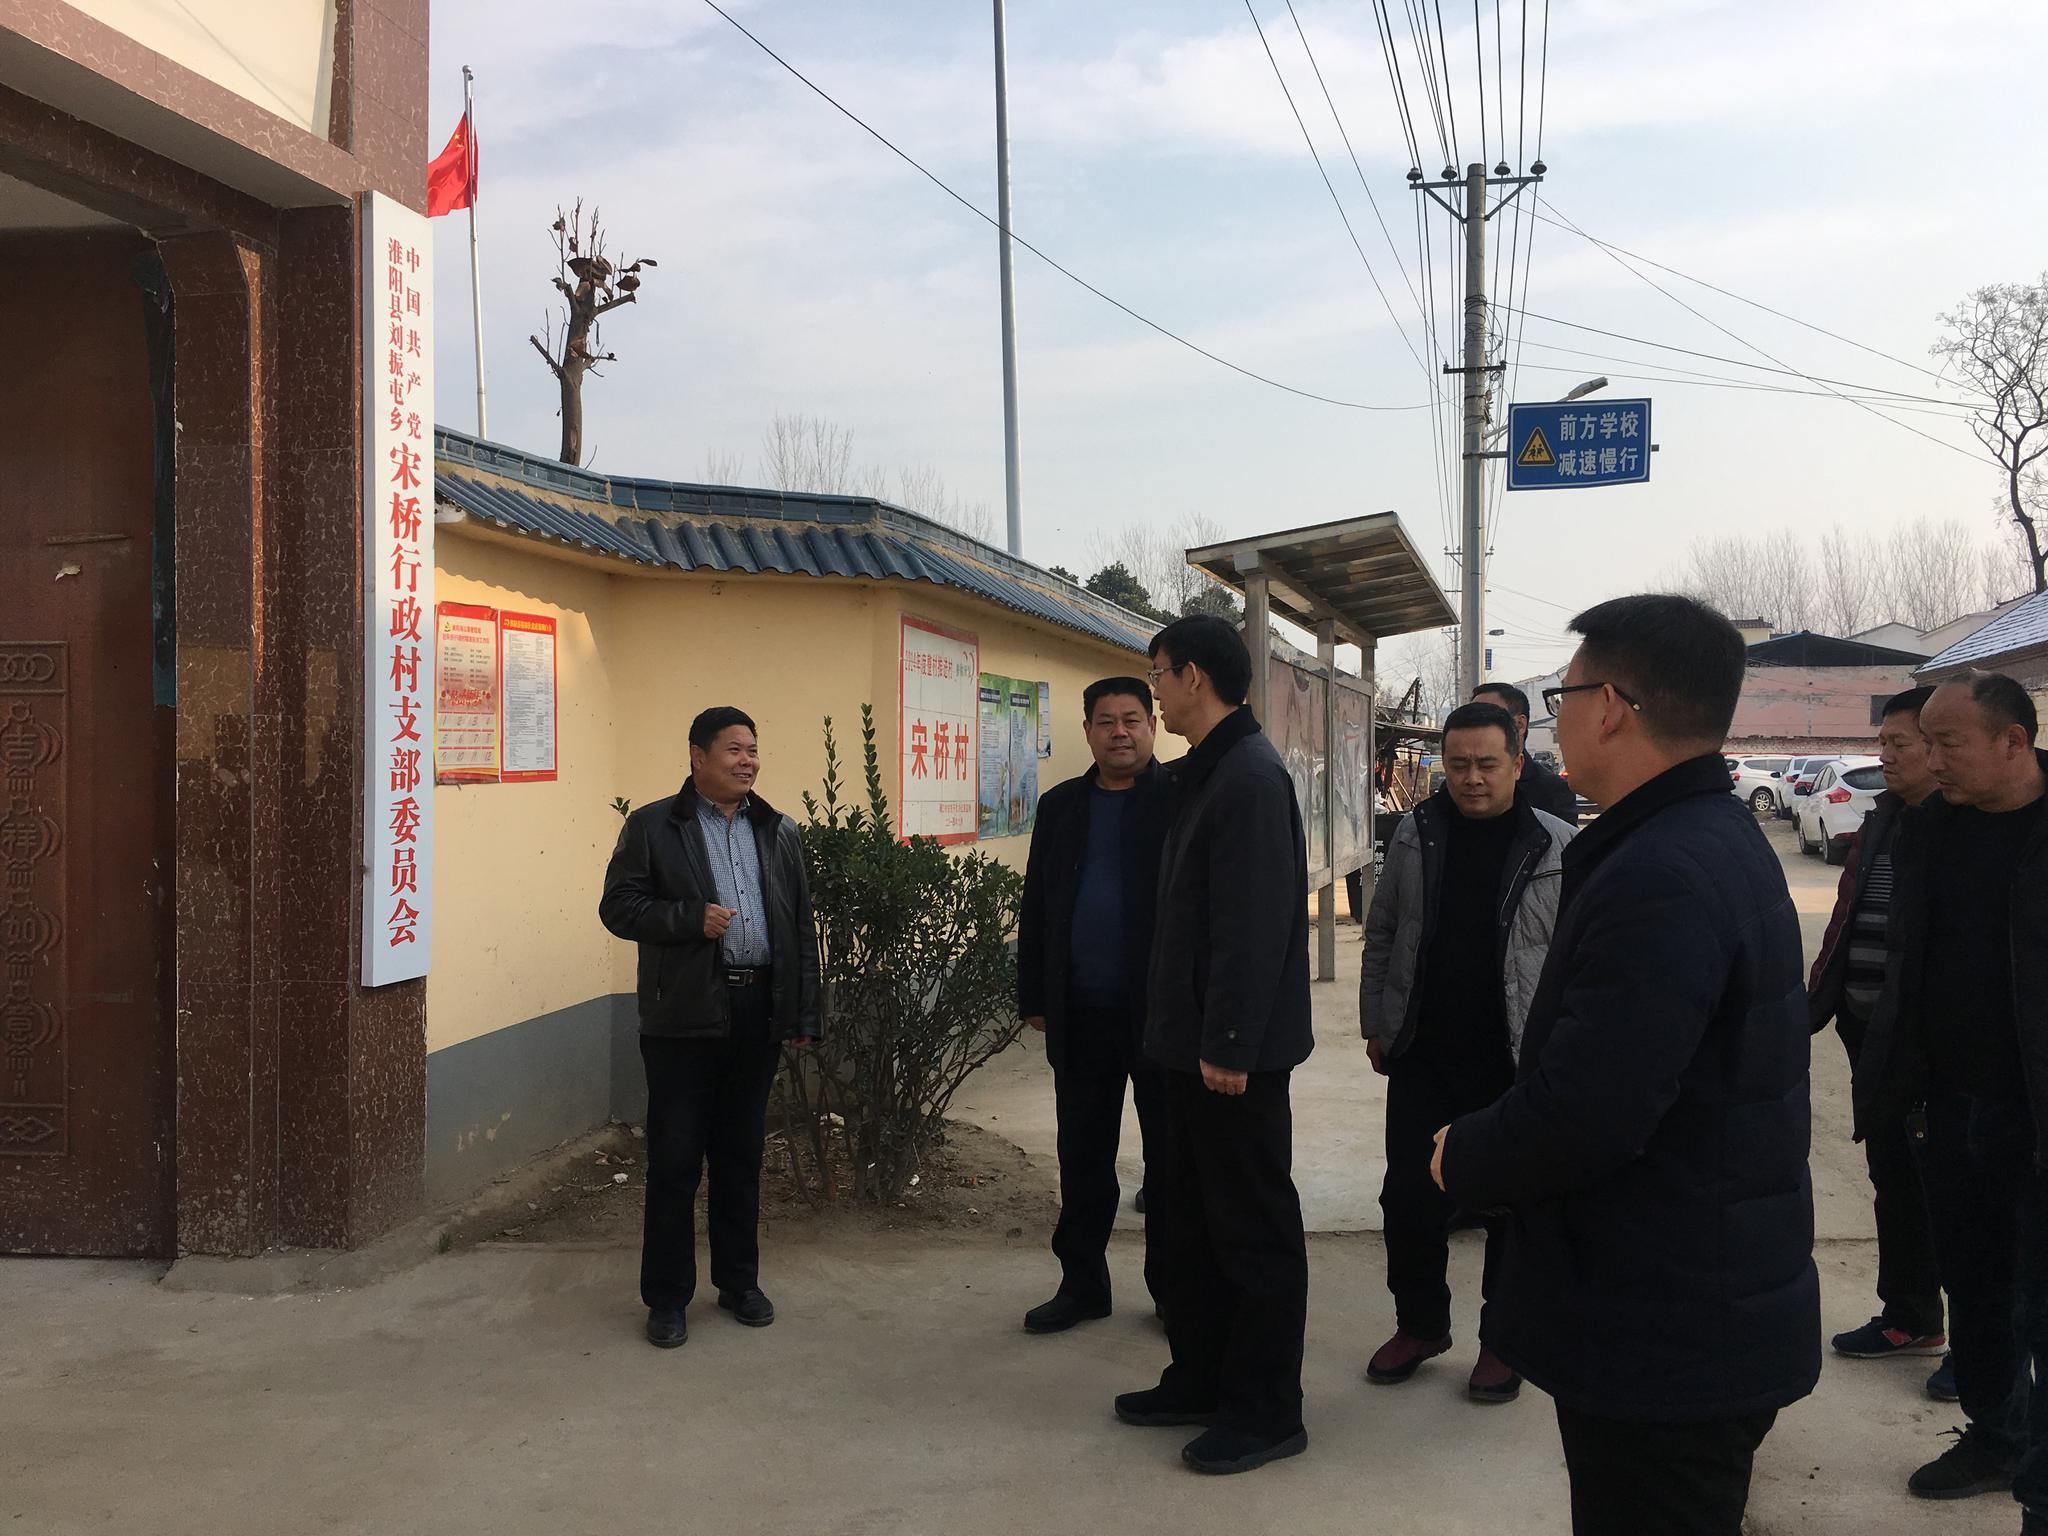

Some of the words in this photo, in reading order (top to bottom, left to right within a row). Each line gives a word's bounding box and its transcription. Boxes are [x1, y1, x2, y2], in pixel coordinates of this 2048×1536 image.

[388, 237, 404, 431] 淮阳县刘振屯乡
[406, 247, 422, 440] 中国共产党
[1557, 446, 1639, 476] 减速慢行
[1559, 411, 1639, 441] 前方学校
[387, 442, 422, 947] 宋桥行政村支部委员会
[911, 718, 968, 780] 宋桥村
